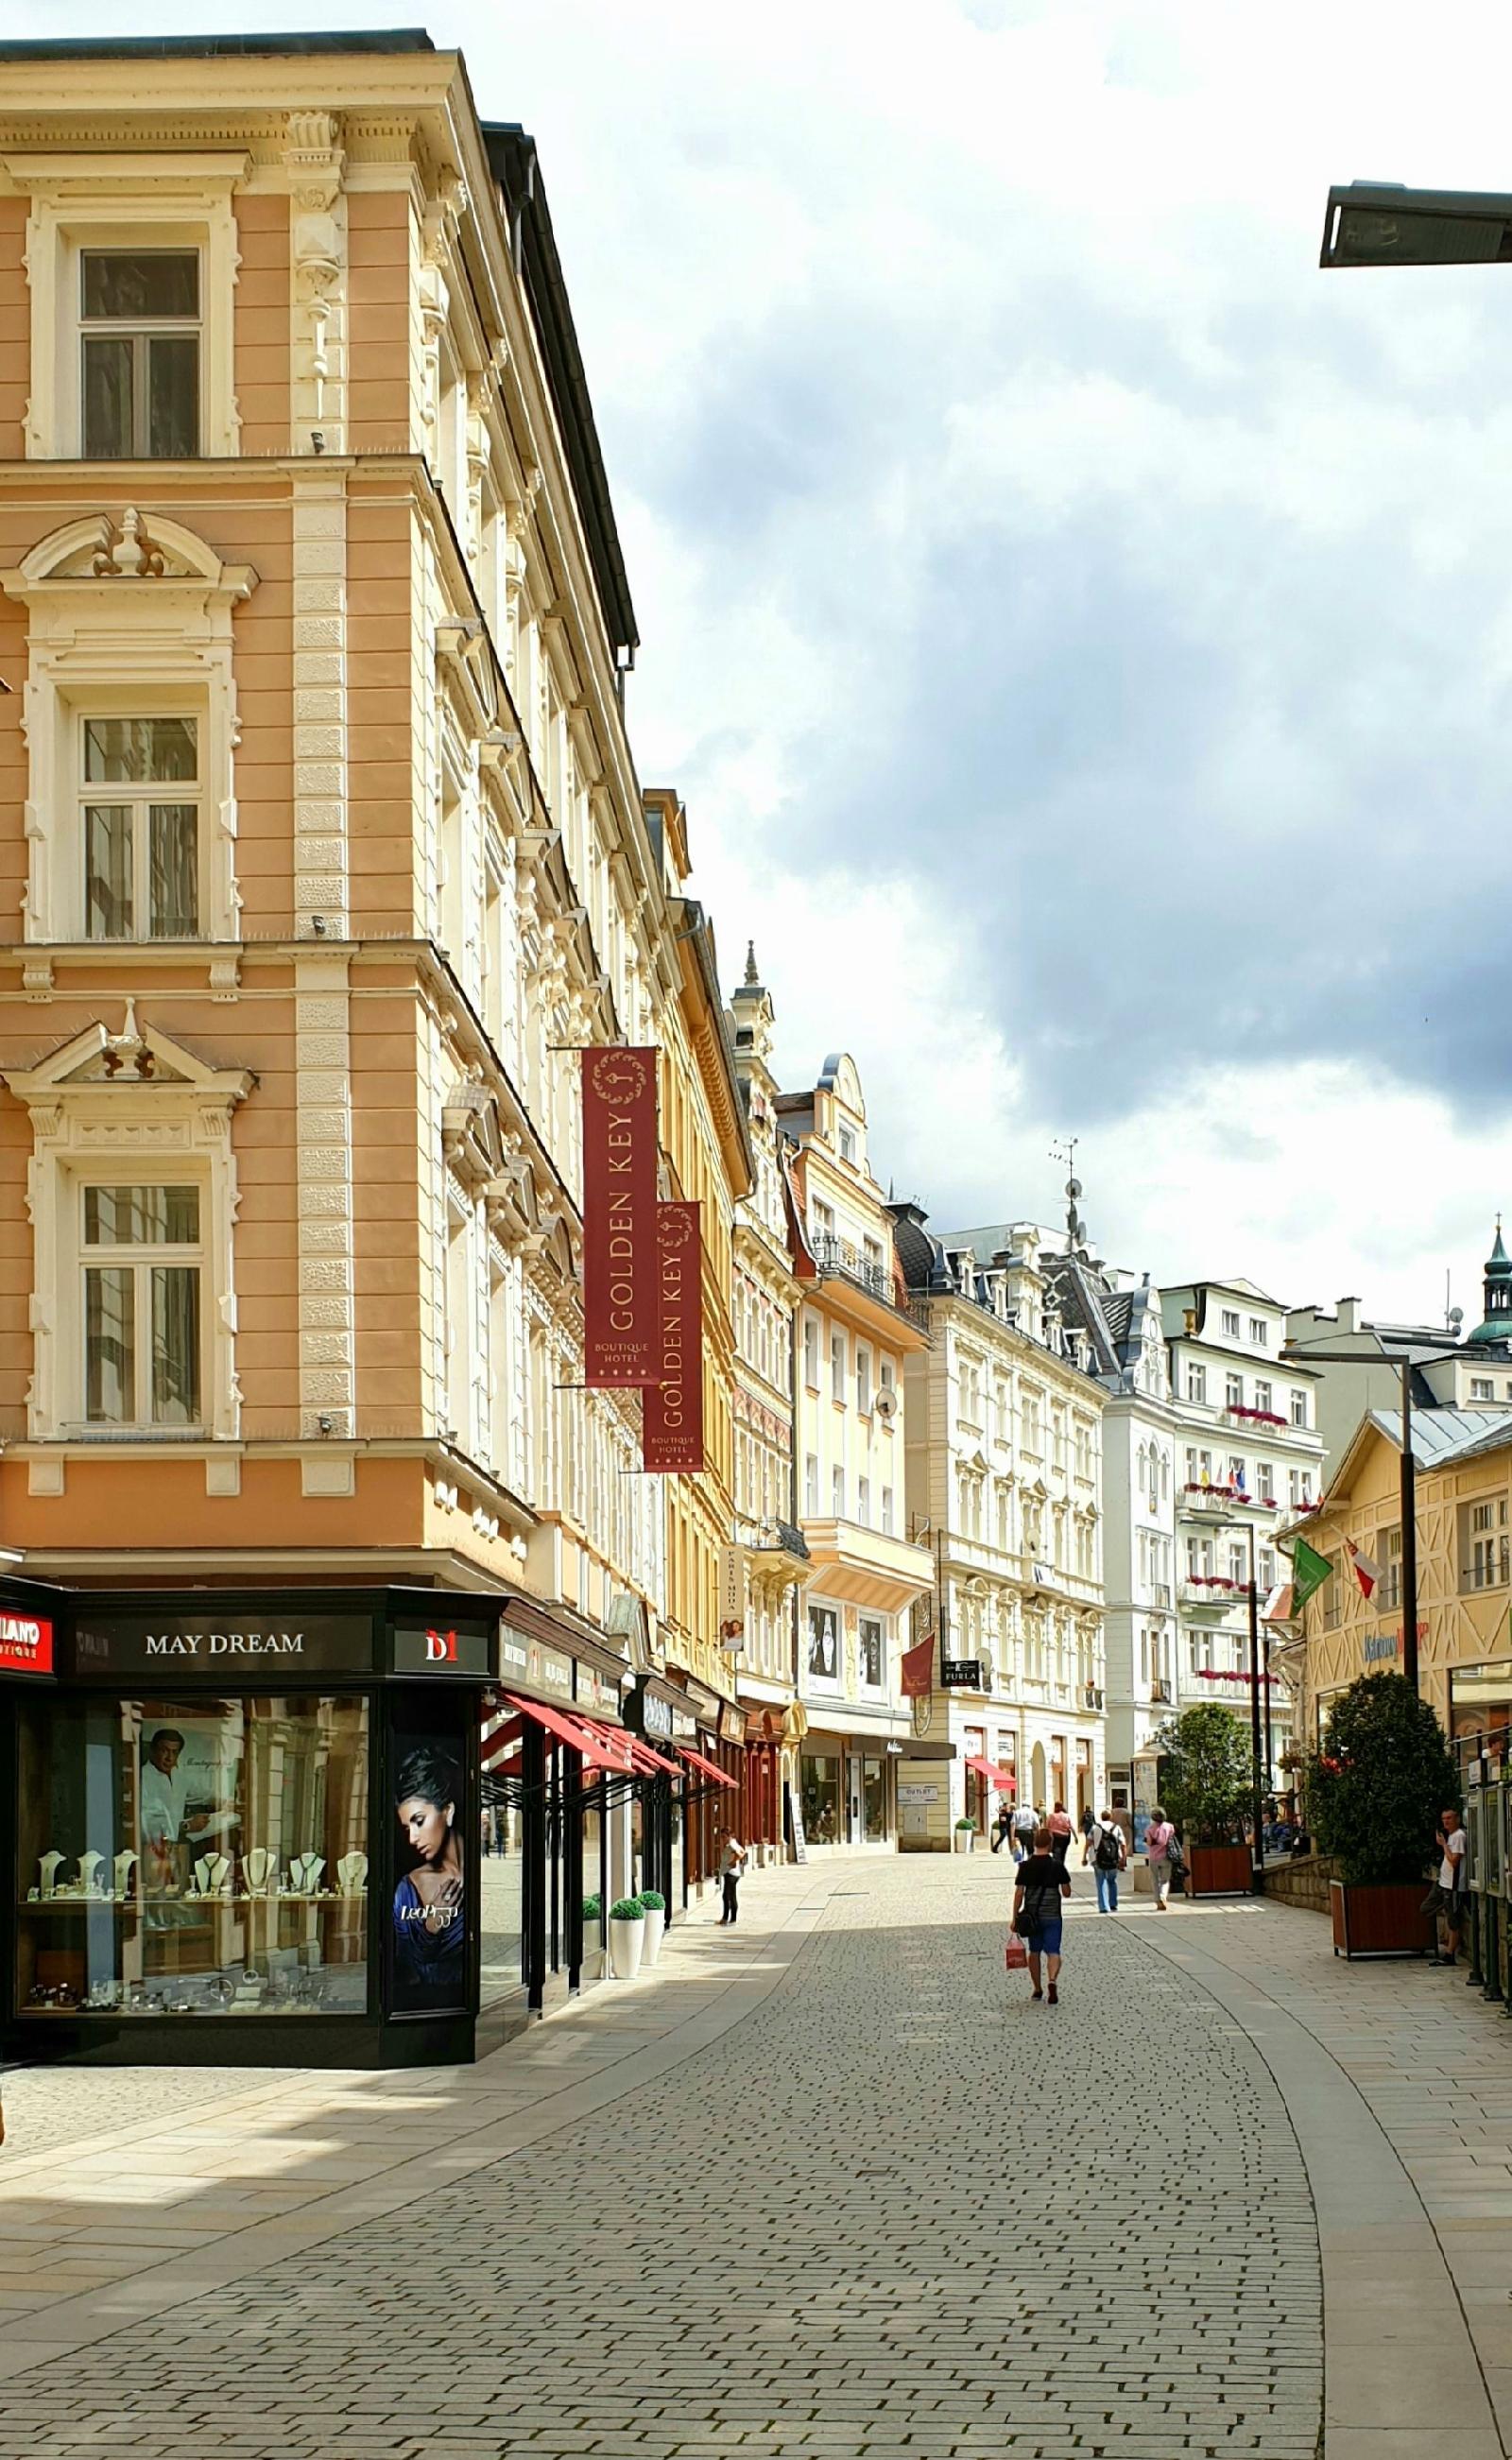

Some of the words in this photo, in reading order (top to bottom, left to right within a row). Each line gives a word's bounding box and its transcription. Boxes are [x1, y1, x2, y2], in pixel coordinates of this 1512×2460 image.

[608, 1111, 632, 1174] KEY
[610, 1193, 634, 1332] GOLDEN
[662, 1253, 681, 1302] KEY
[594, 1342, 649, 1353] BOUTIQUE
[605, 1353, 640, 1363] HOTEL
[663, 1316, 683, 1428] GOLDEN
[651, 1436, 696, 1446] BOUTIQUE
[659, 1446, 688, 1454] HOTEL
[0, 1616, 40, 1645] LANO
[145, 1634, 203, 1654] MAY
[208, 1633, 304, 1654] DREAM
